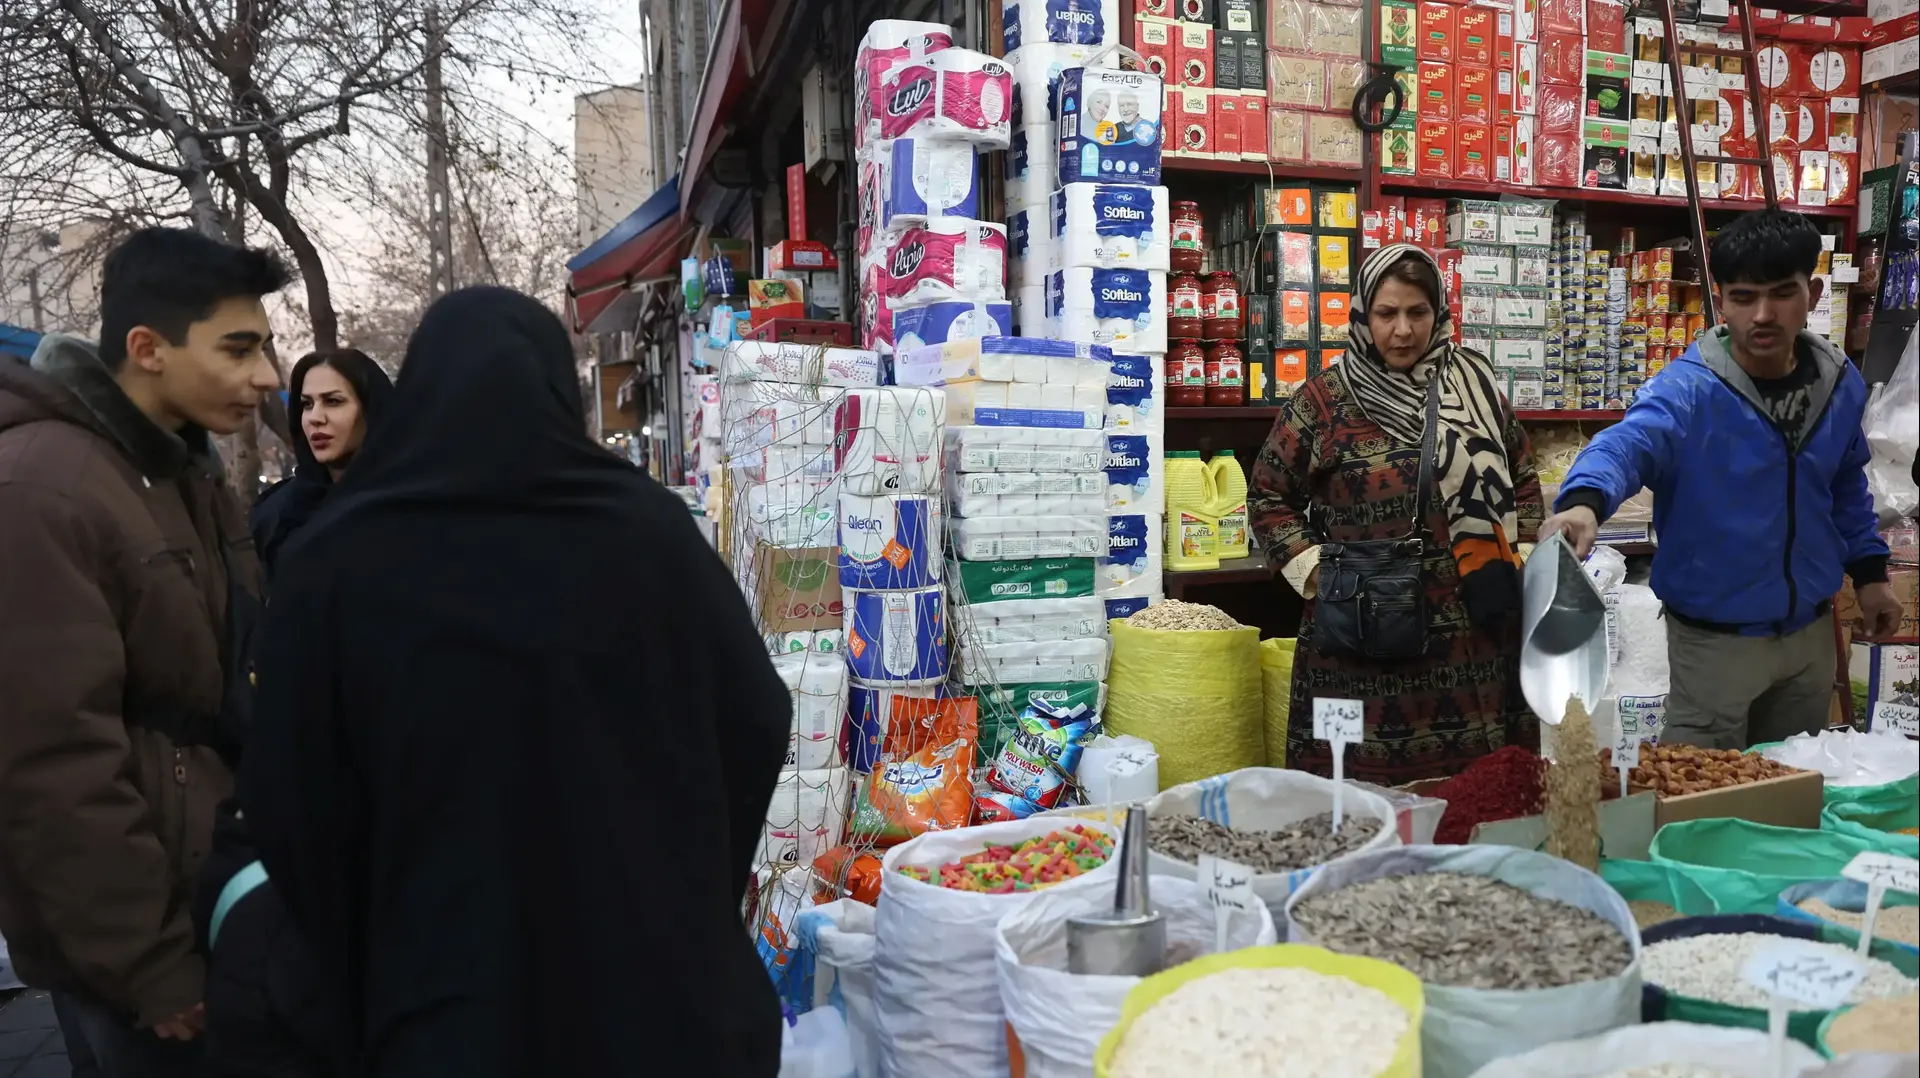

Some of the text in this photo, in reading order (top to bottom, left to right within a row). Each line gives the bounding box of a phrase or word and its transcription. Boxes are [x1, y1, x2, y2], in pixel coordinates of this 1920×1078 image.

[1102, 73, 1143, 85] EasyLife
[1104, 206, 1145, 220] Softlan
[1094, 248, 1103, 256] 12
[1101, 288, 1142, 301] Softlan
[1092, 330, 1101, 338] 12
[1019, 758, 1045, 776] WASH
